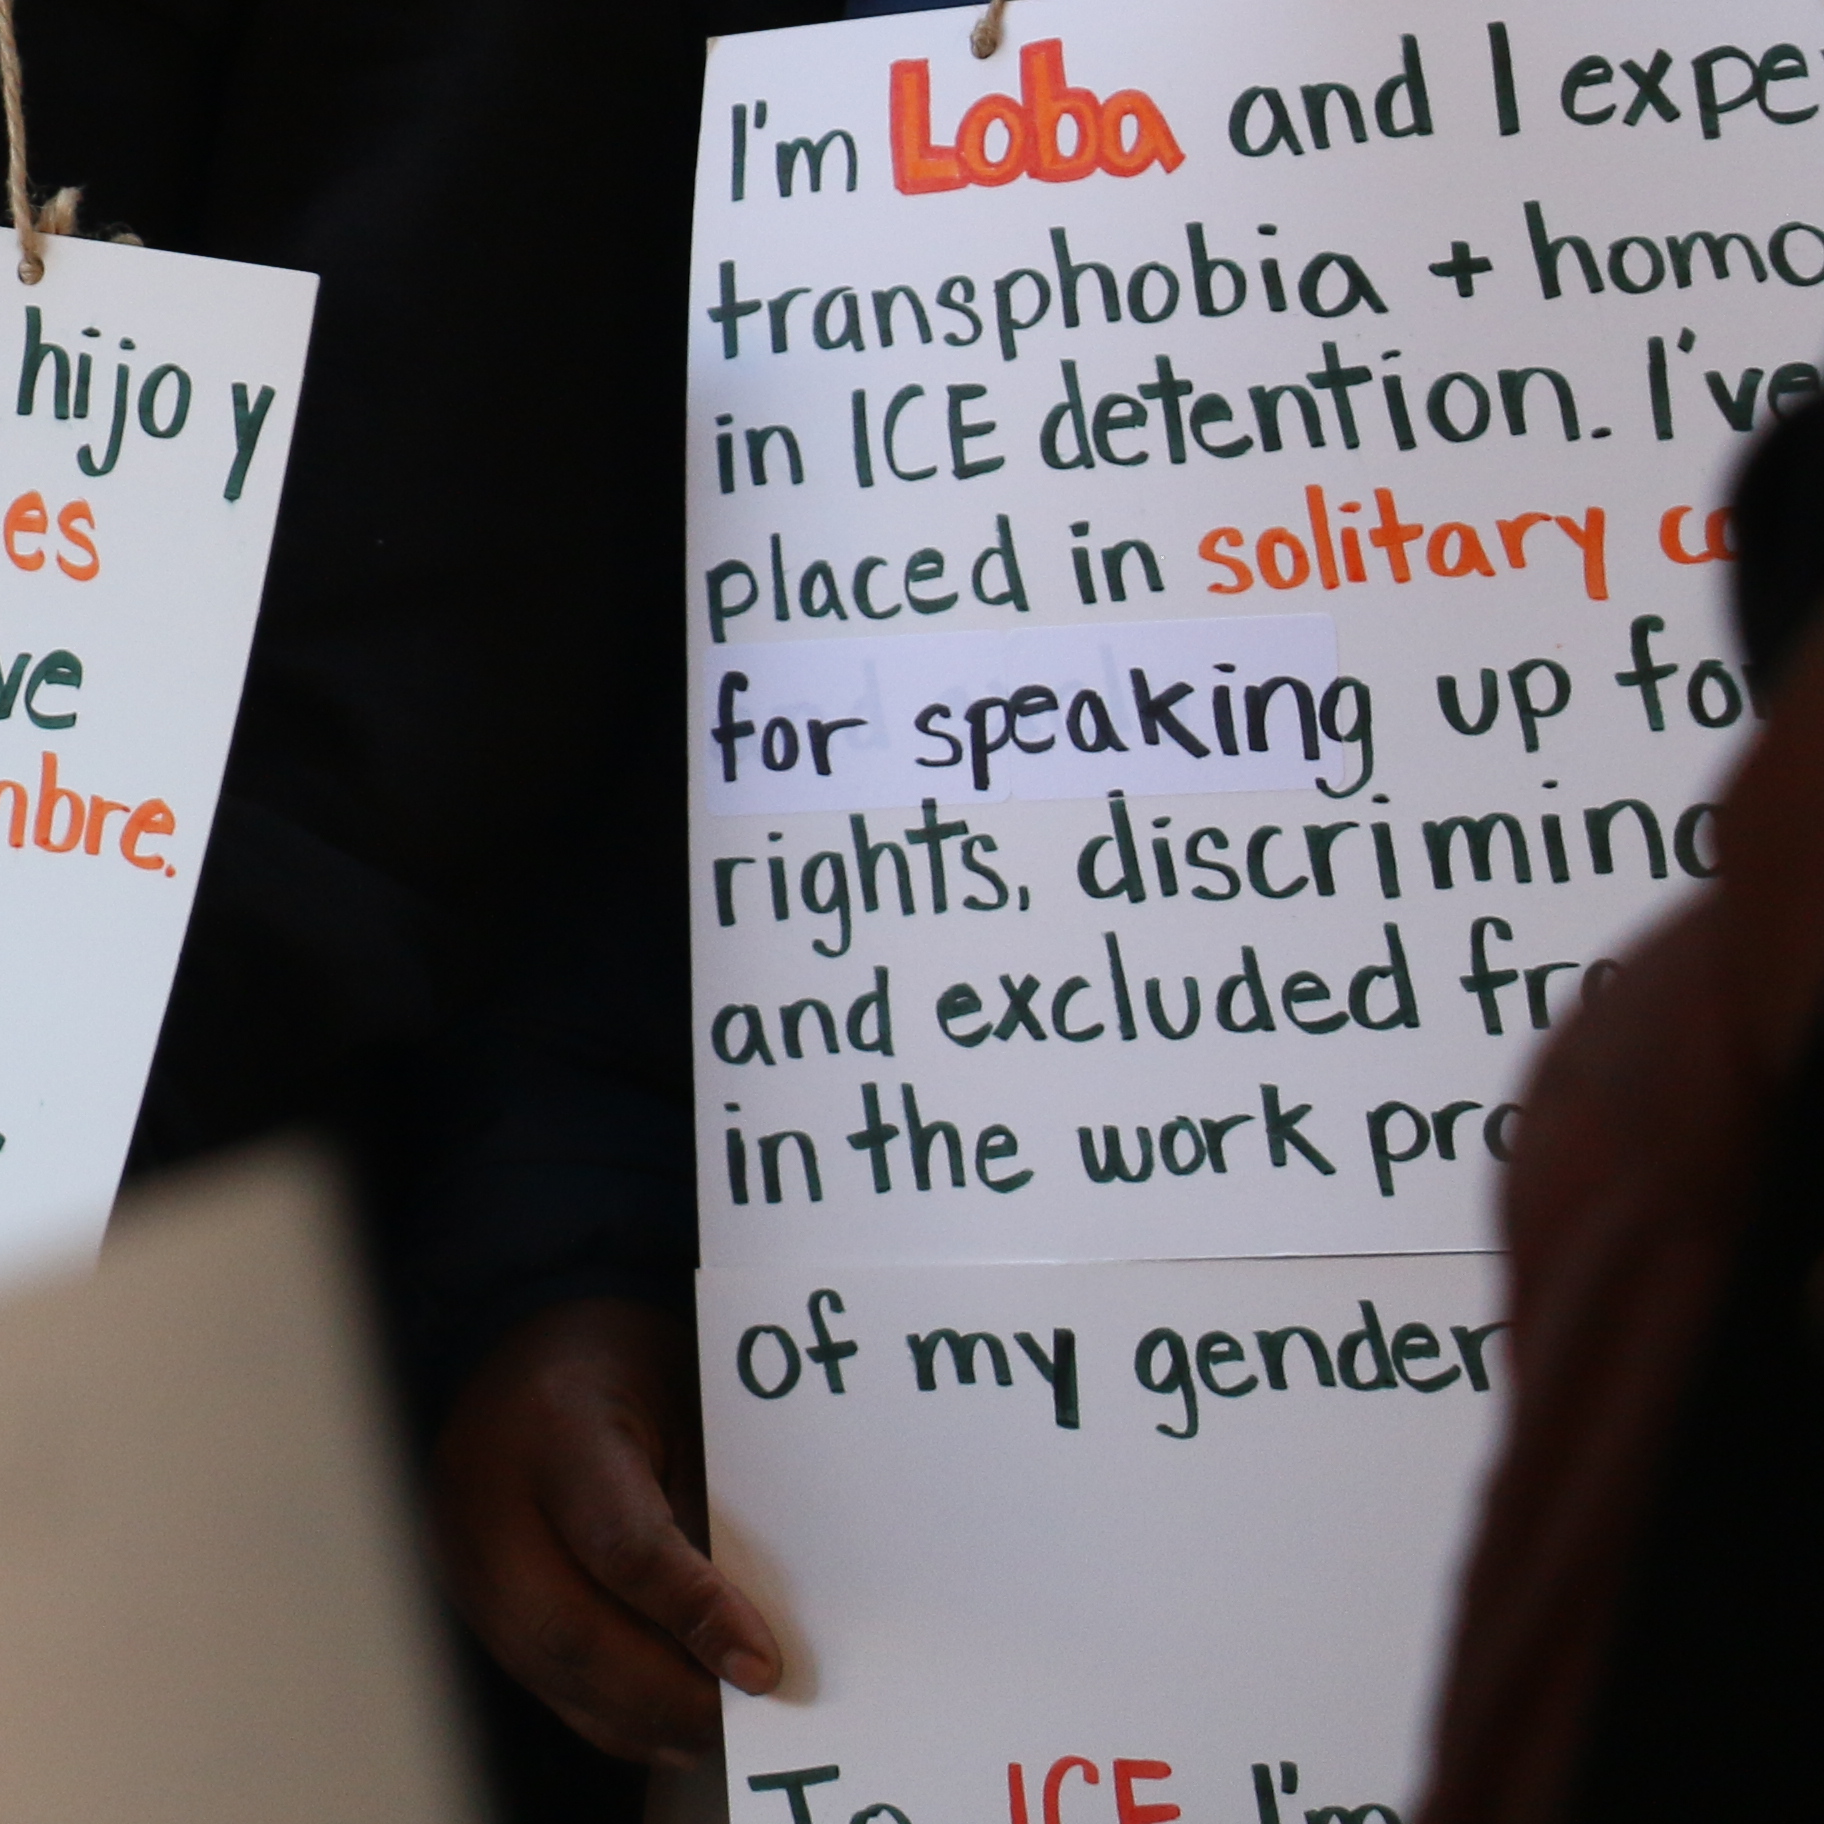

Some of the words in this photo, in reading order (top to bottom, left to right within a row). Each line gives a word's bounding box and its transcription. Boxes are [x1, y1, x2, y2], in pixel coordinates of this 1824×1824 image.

[731, 100, 858, 202] I'm
[889, 38, 1186, 196] Loba
[1228, 33, 1434, 157] and
[1487, 21, 1521, 137] I
[1560, 43, 1819, 140] expe
[707, 221, 1389, 361] transphobia
[1428, 241, 1493, 298] +
[1523, 200, 1824, 300] homo
[16, 306, 192, 478] hijo
[223, 382, 276, 504] y
[715, 413, 804, 495] in
[851, 384, 1005, 489] ICE
[1040, 341, 1612, 470] detention.
[1647, 327, 1824, 441] I've
[705, 514, 1030, 644] placed
[1069, 521, 1165, 605] in
[1199, 484, 1609, 601] solitary
[710, 671, 868, 783] for
[915, 663, 1374, 798] speaking
[1436, 658, 1572, 753] up
[1614, 614, 1768, 732] fo
[713, 798, 1030, 959] rights,
[711, 966, 895, 1067] and
[936, 922, 1421, 1048] excluded
[724, 1102, 823, 1206] in
[846, 1082, 1034, 1194] the
[1076, 1084, 1337, 1184] work
[736, 1289, 858, 1401] of
[906, 1328, 1080, 1430] my
[1134, 1298, 1512, 1440] gender
[1250, 1761, 1404, 1824] I'
